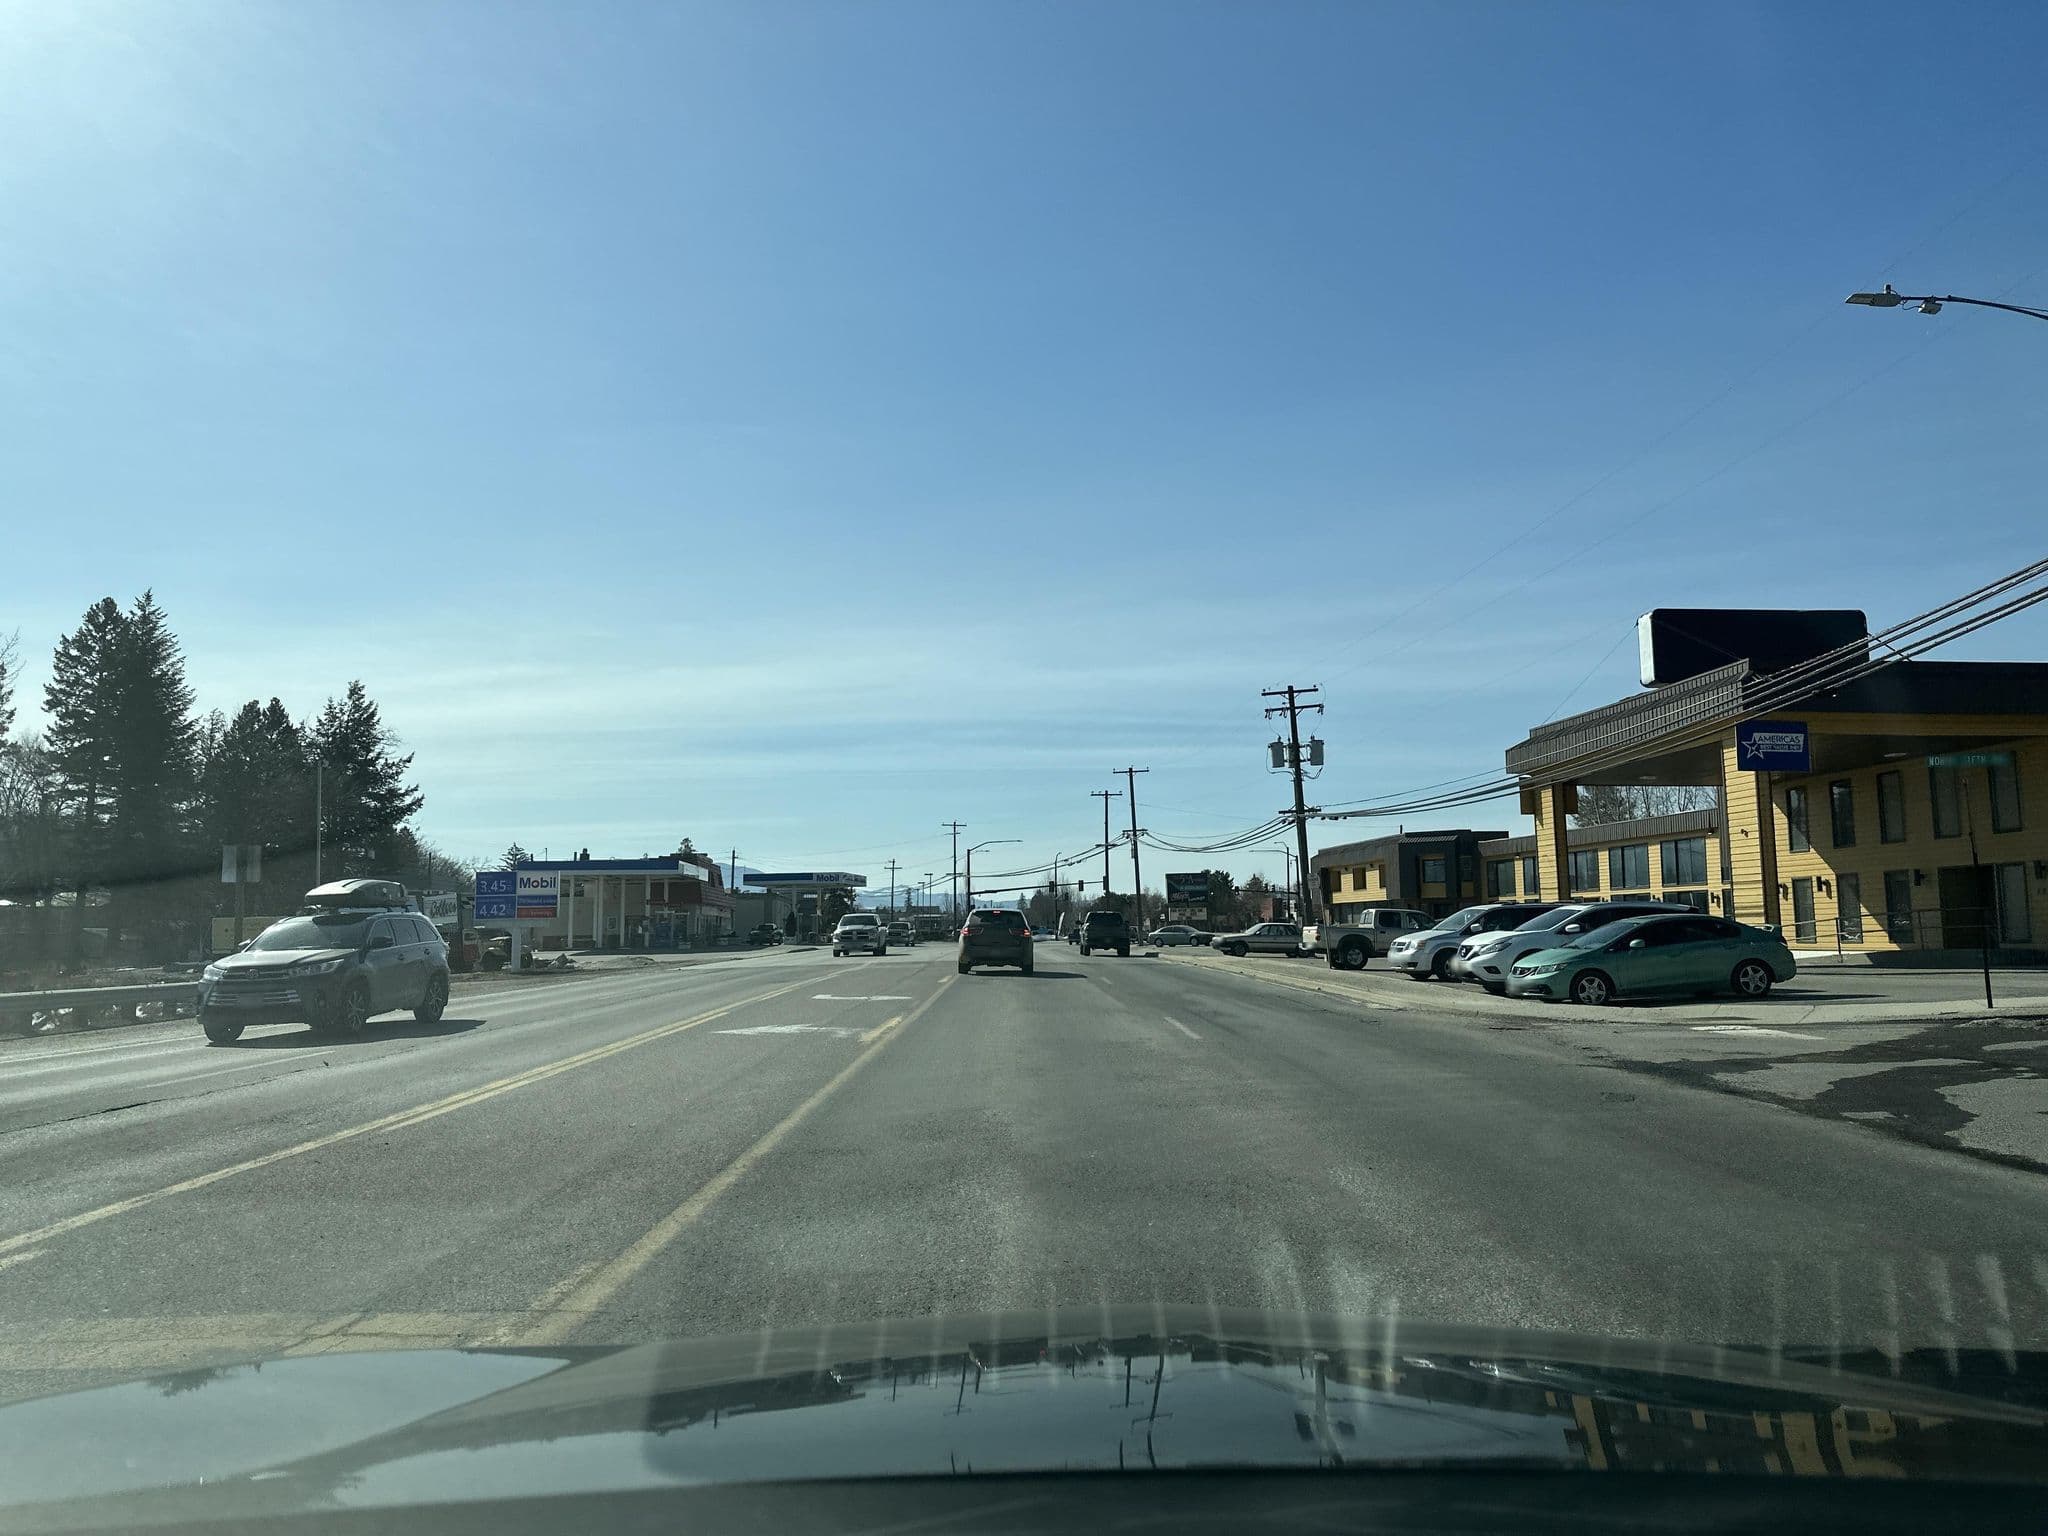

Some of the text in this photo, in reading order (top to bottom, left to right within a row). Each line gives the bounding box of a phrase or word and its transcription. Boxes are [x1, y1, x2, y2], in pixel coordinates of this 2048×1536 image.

[1758, 735, 1800, 743] AMERICAS
[816, 874, 840, 882] Mobil
[519, 877, 556, 888] Mobil
